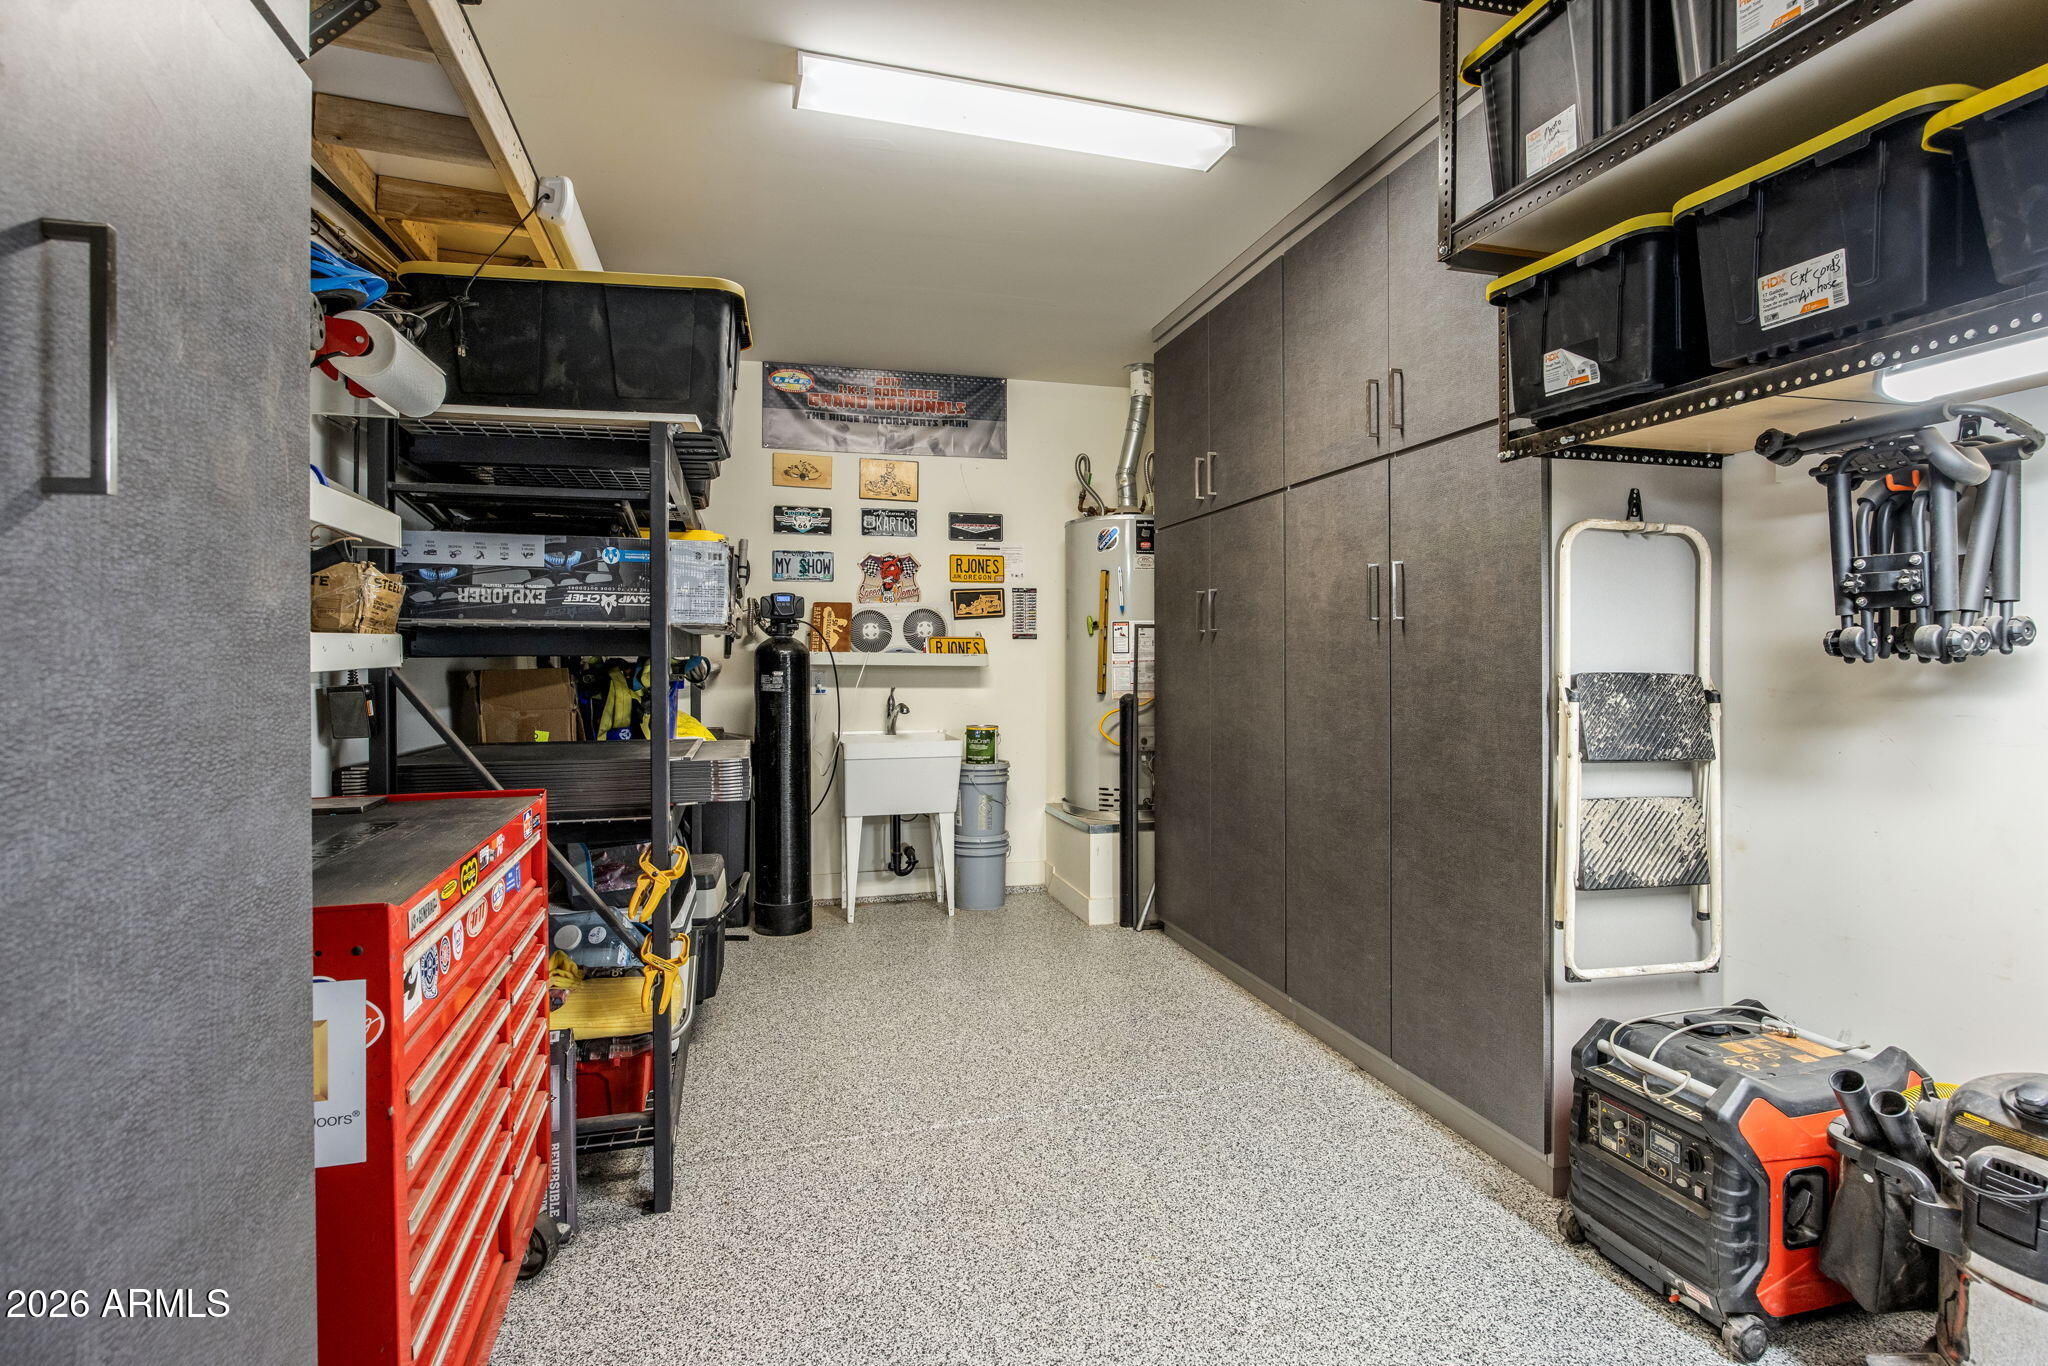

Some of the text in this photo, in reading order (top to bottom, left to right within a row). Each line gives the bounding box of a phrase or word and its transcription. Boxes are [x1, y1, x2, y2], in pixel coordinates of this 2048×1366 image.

[1761, 272, 1787, 291] HDX
[1790, 267, 1813, 287] Ext
[1799, 286, 1816, 303] Air
[875, 376, 903, 387] 2017
[838, 384, 939, 400] I.K.F. ROAD RACE
[807, 392, 967, 416] GRAND NATIONALS
[805, 411, 969, 428] THE RIDGE MOTORSPORTS PARK
[775, 557, 791, 574] MY
[963, 573, 992, 581] OREGON
[457, 587, 547, 605] EXPLORER
[563, 593, 601, 603] CHEF
[549, 1141, 560, 1218] REVERSIBLE
